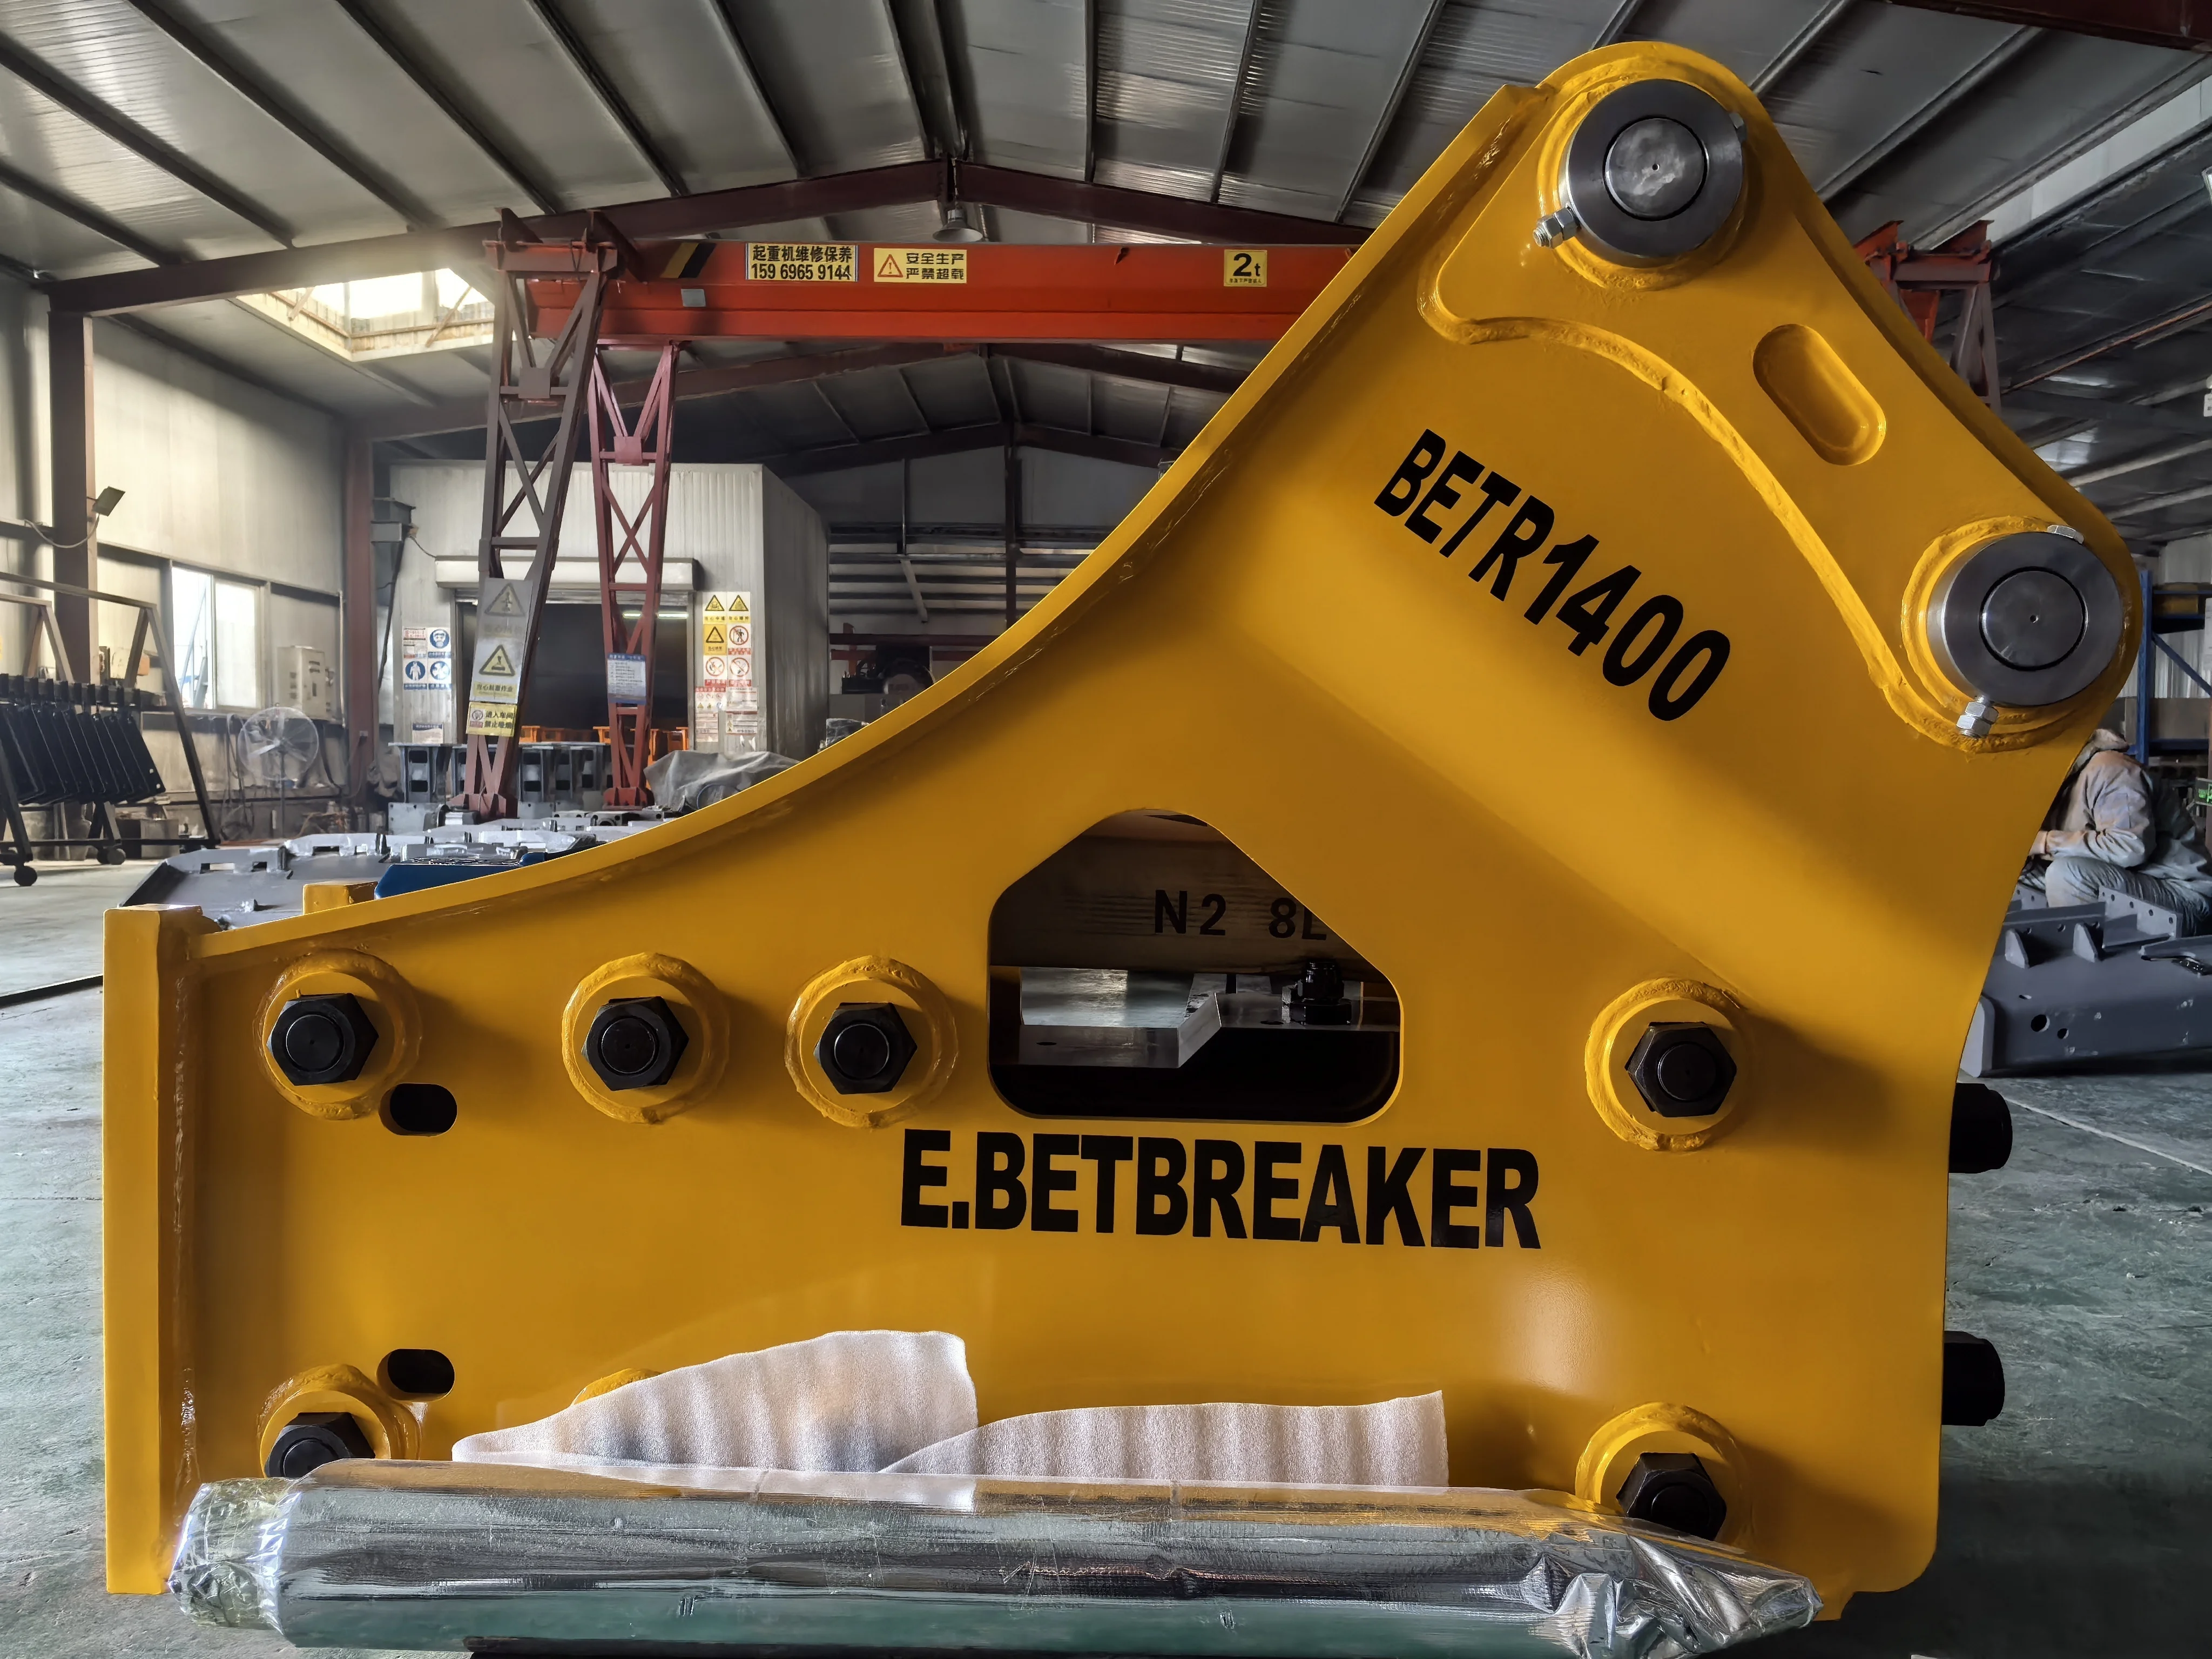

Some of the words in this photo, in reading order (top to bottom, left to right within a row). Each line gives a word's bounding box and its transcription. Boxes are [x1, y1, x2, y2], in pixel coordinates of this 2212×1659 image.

[752, 245, 852, 263] 起重机维修保养
[906, 253, 964, 265] 安全生产
[751, 263, 776, 279] 159
[780, 264, 813, 280] 6965
[818, 264, 852, 280] 9144
[1232, 253, 1260, 276] 2t
[906, 268, 964, 280] 严禁超载
[1374, 428, 1731, 721] BETR1400
[901, 1128, 1541, 1249] E.BETBREAKER
